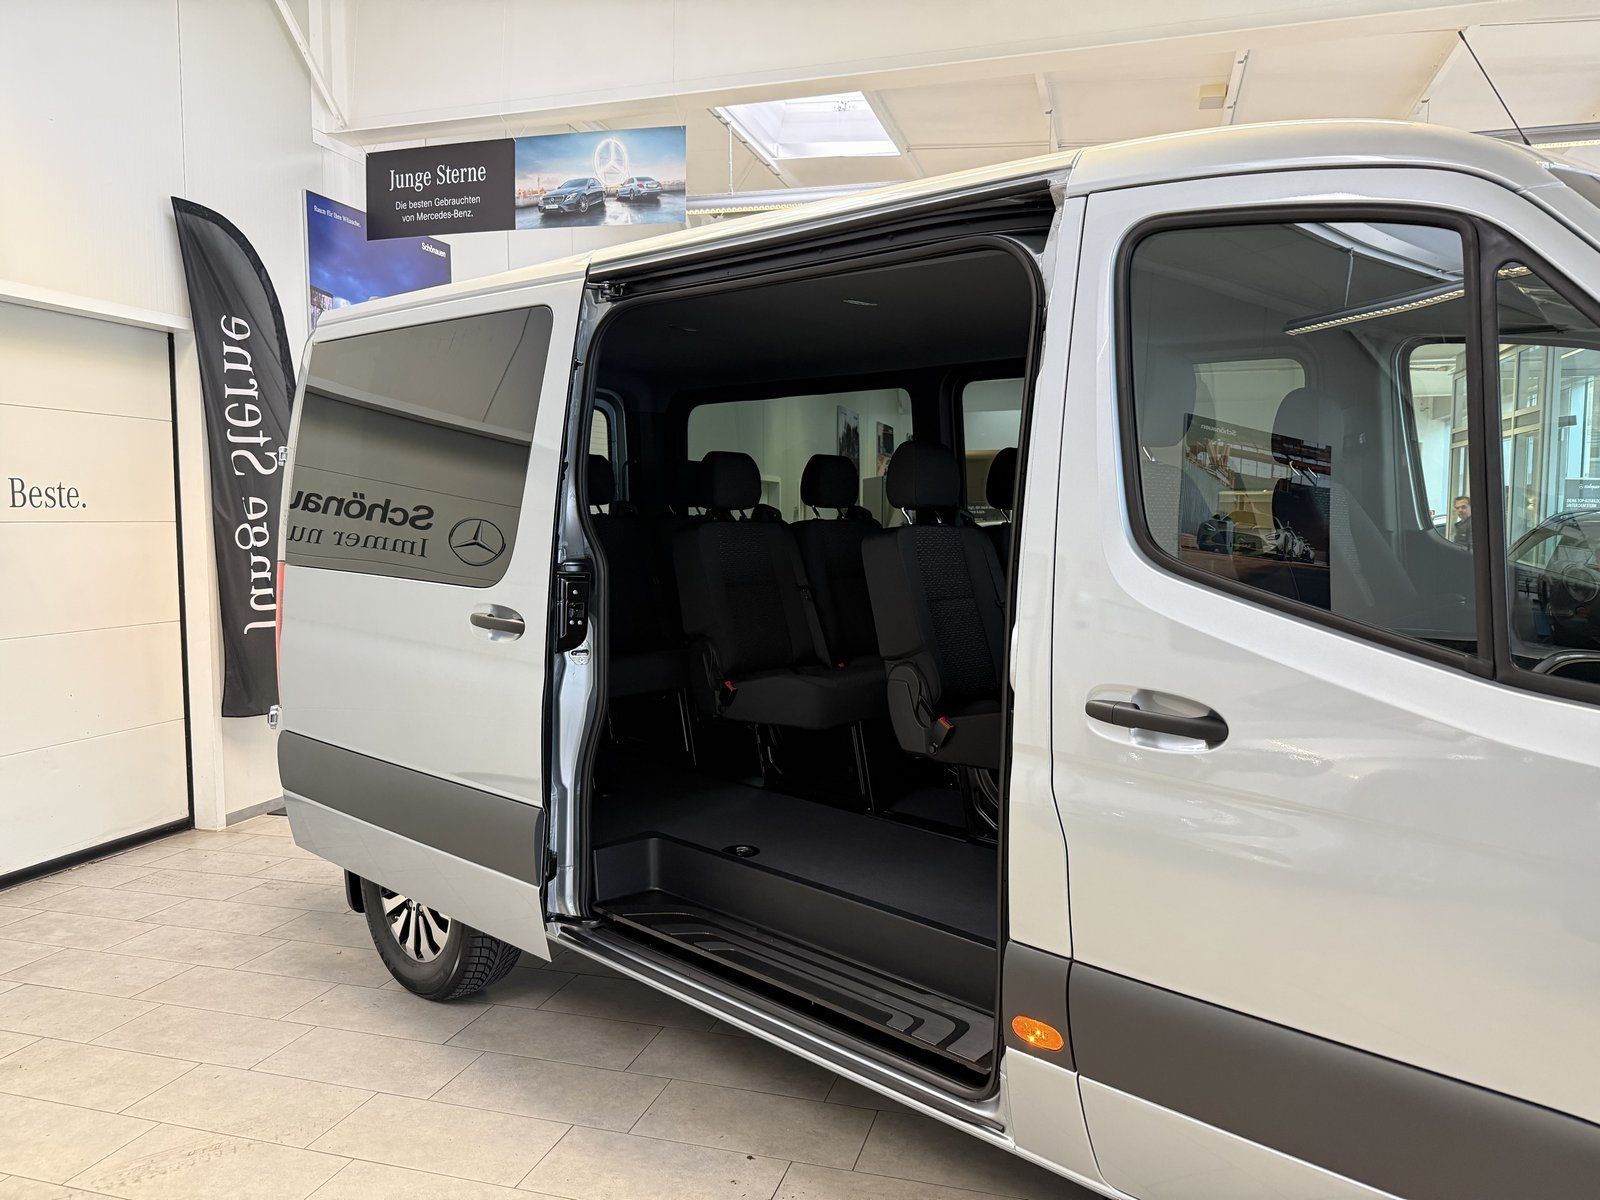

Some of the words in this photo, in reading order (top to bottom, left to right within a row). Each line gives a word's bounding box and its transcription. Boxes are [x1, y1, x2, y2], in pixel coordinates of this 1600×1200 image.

[389, 169, 432, 192] Junge
[436, 164, 487, 186] Sterne
[395, 201, 407, 211] Die
[408, 198, 433, 210] besten
[434, 195, 481, 207] Gebrauchten
[402, 213, 415, 223] von
[416, 208, 474, 222] Mercedes-Benz.
[7, 477, 87, 509] Beste.
